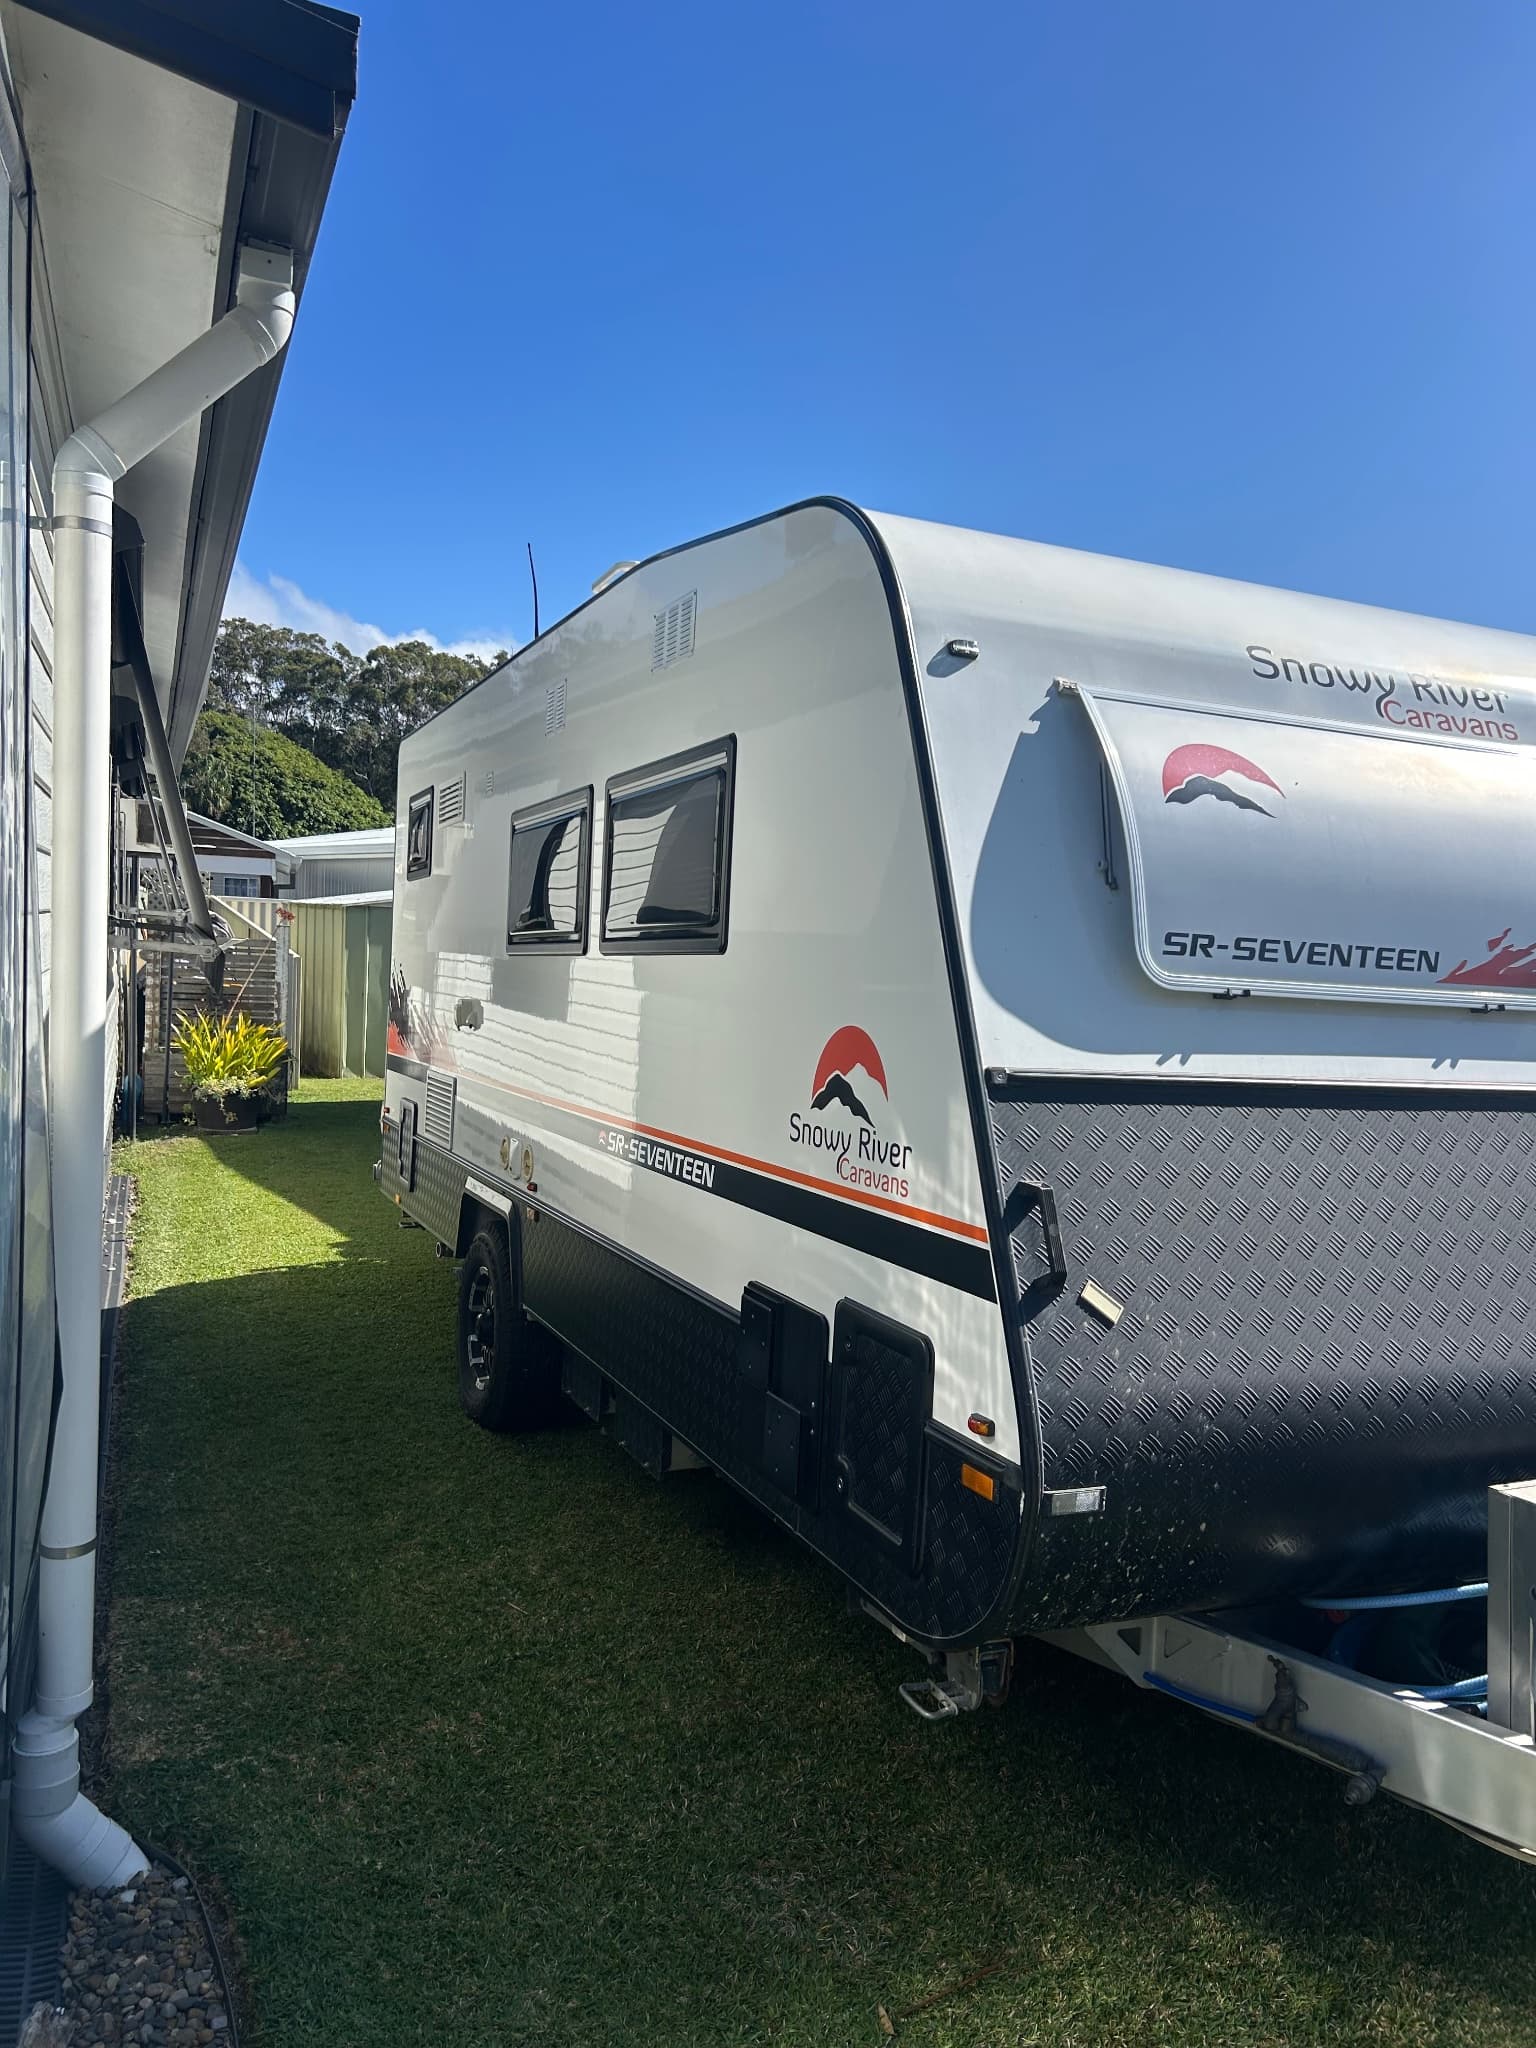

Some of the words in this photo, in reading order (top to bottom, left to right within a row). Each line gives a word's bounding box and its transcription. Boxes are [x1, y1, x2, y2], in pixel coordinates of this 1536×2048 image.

[1246, 645, 1396, 718] Snowy
[1411, 671, 1510, 713] River
[1382, 699, 1519, 742] Caravans
[1162, 931, 1441, 974] SR-SEVENTEEN
[607, 1130, 715, 1189] SR-SEVENTEEN
[789, 1112, 852, 1174] Snowy
[858, 1127, 913, 1170] River
[839, 1156, 909, 1198] Caravans
